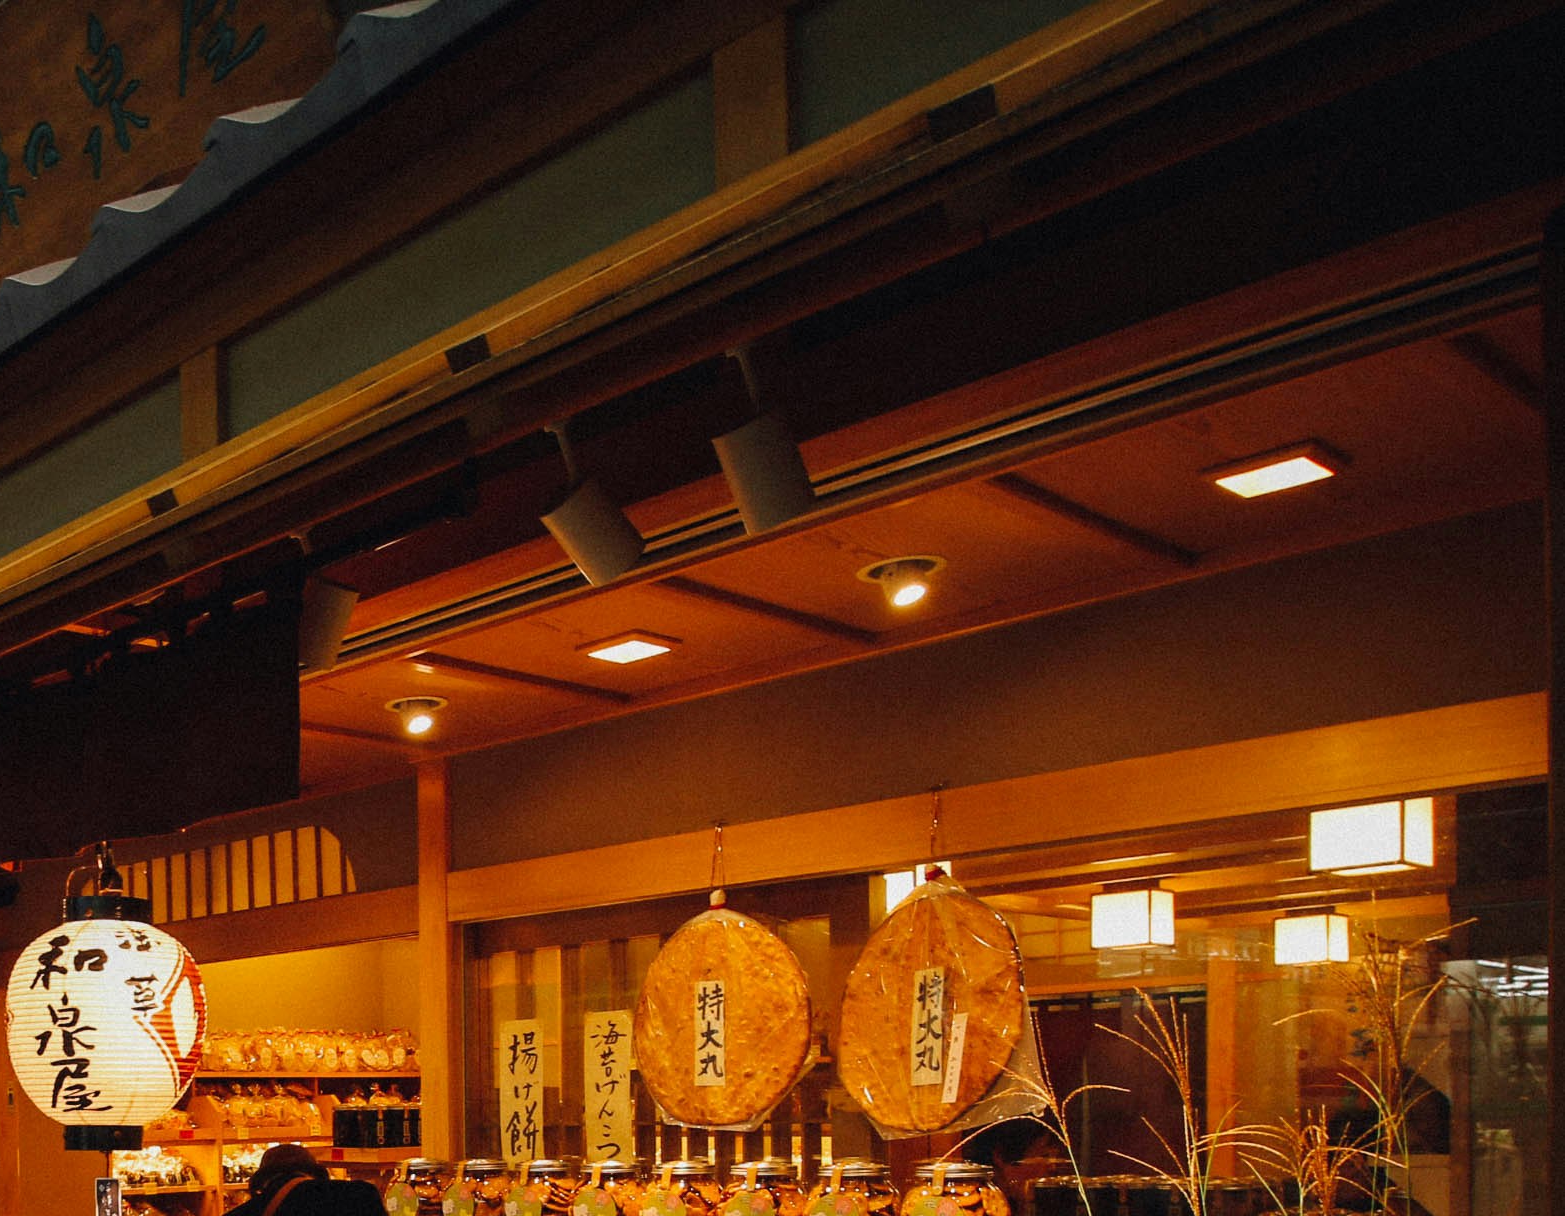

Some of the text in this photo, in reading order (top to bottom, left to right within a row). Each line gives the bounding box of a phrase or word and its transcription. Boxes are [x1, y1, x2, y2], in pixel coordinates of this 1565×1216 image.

[30, 934, 114, 1113] 和泉屋
[695, 984, 725, 1079] 特大丸
[915, 971, 943, 1073] 特大丸
[505, 1031, 540, 1161] 揚げ餅
[589, 1020, 628, 1159] 海苔げんこつ
